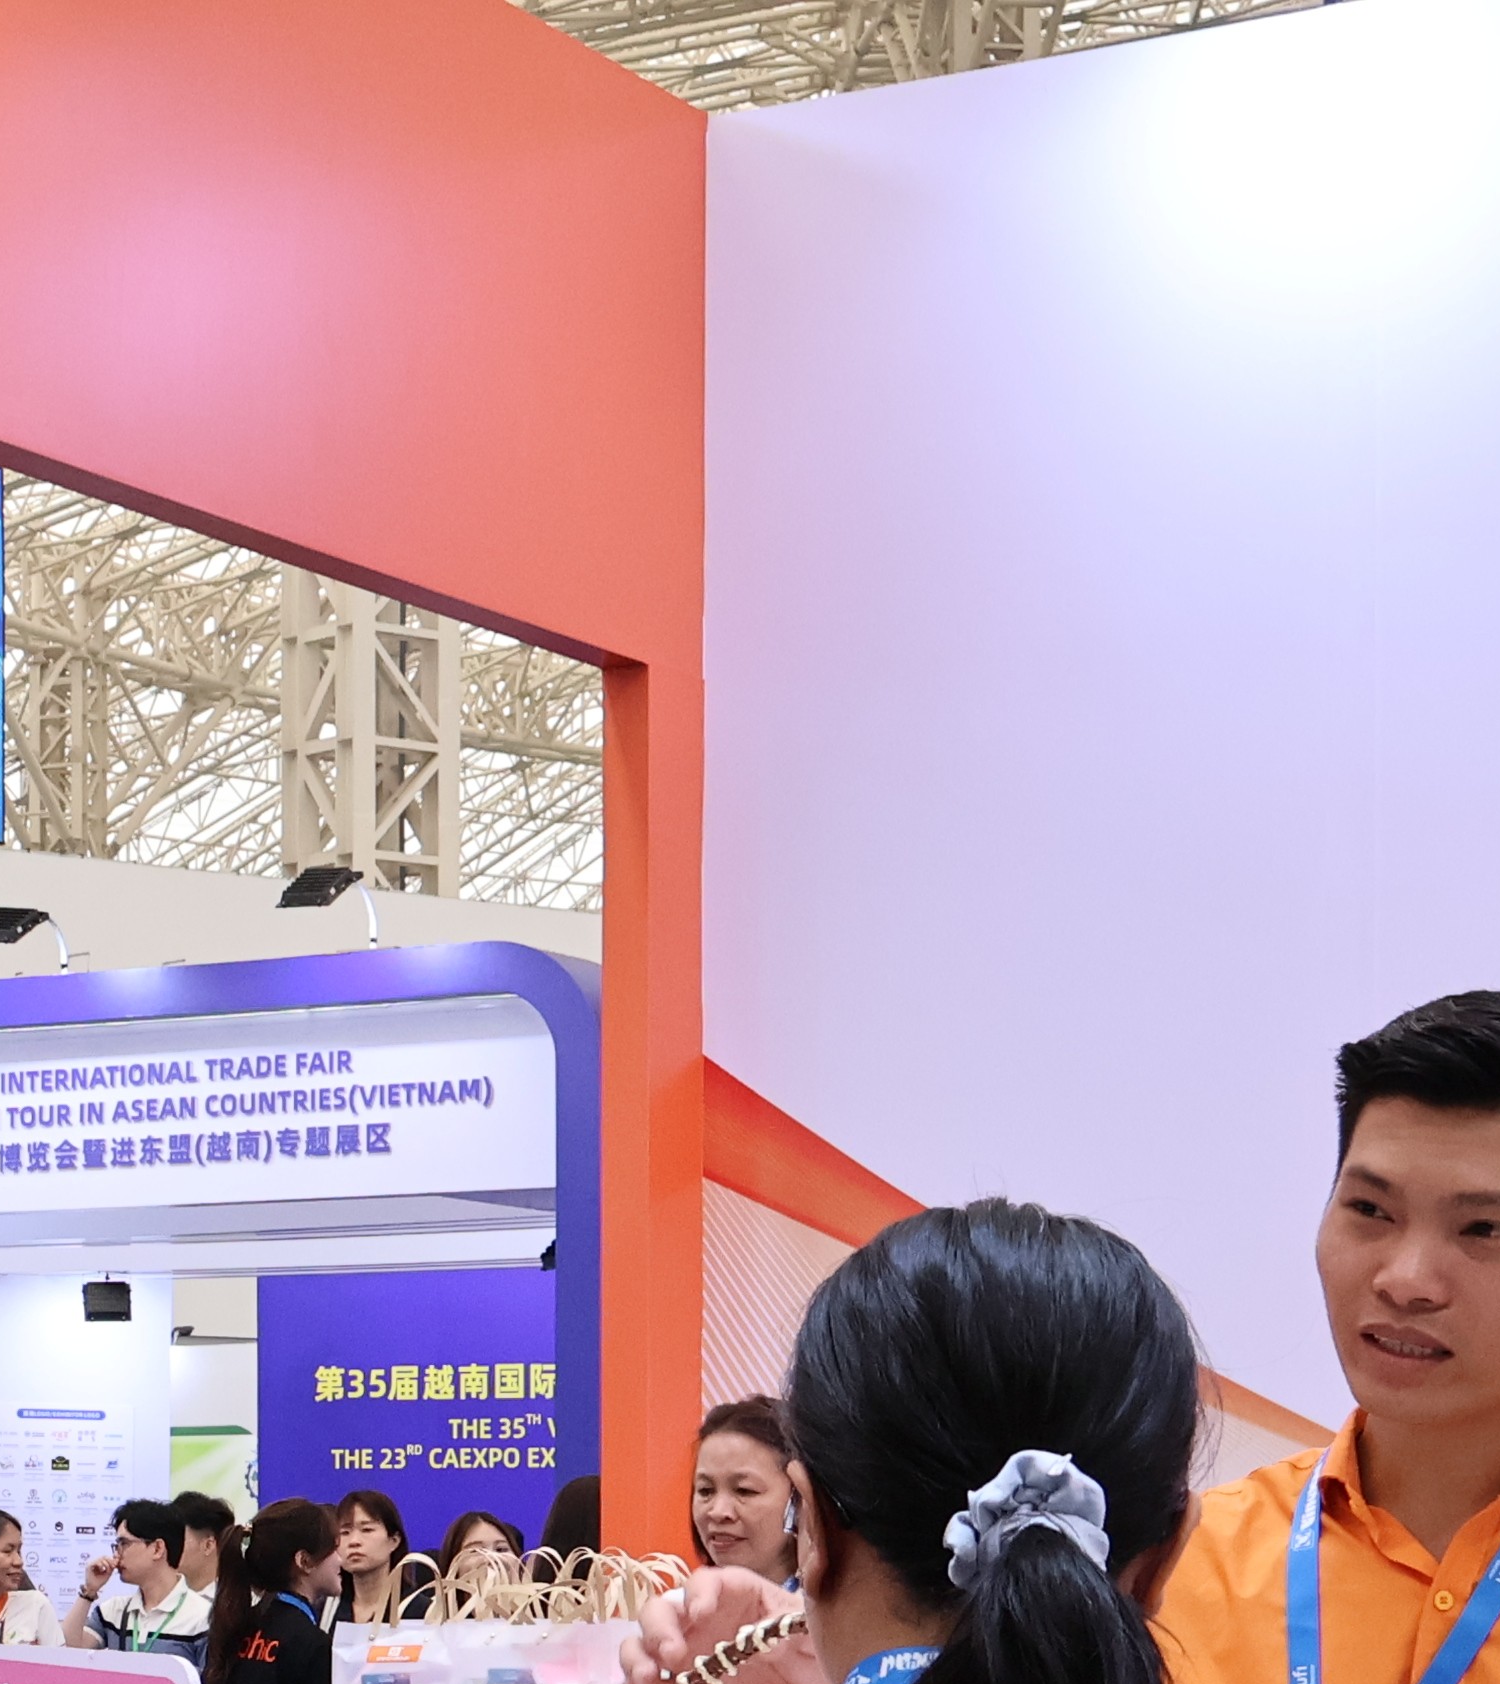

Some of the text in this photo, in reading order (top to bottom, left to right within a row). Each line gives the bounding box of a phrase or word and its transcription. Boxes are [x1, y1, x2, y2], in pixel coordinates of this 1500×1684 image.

[0, 1060, 200, 1095] INTERNATIONAL
[204, 1054, 288, 1083] TRADE
[294, 1048, 354, 1076] FAIR
[6, 1102, 71, 1130] TOUR
[78, 1100, 105, 1125] IN
[111, 1096, 198, 1123] ASEAN
[204, 1075, 495, 1118] COUNTRIES(VIETNAM)
[313, 1362, 557, 1403] 第35届越南国际
[448, 1417, 493, 1440] THE
[330, 1446, 521, 1470] THE CAEXPO
